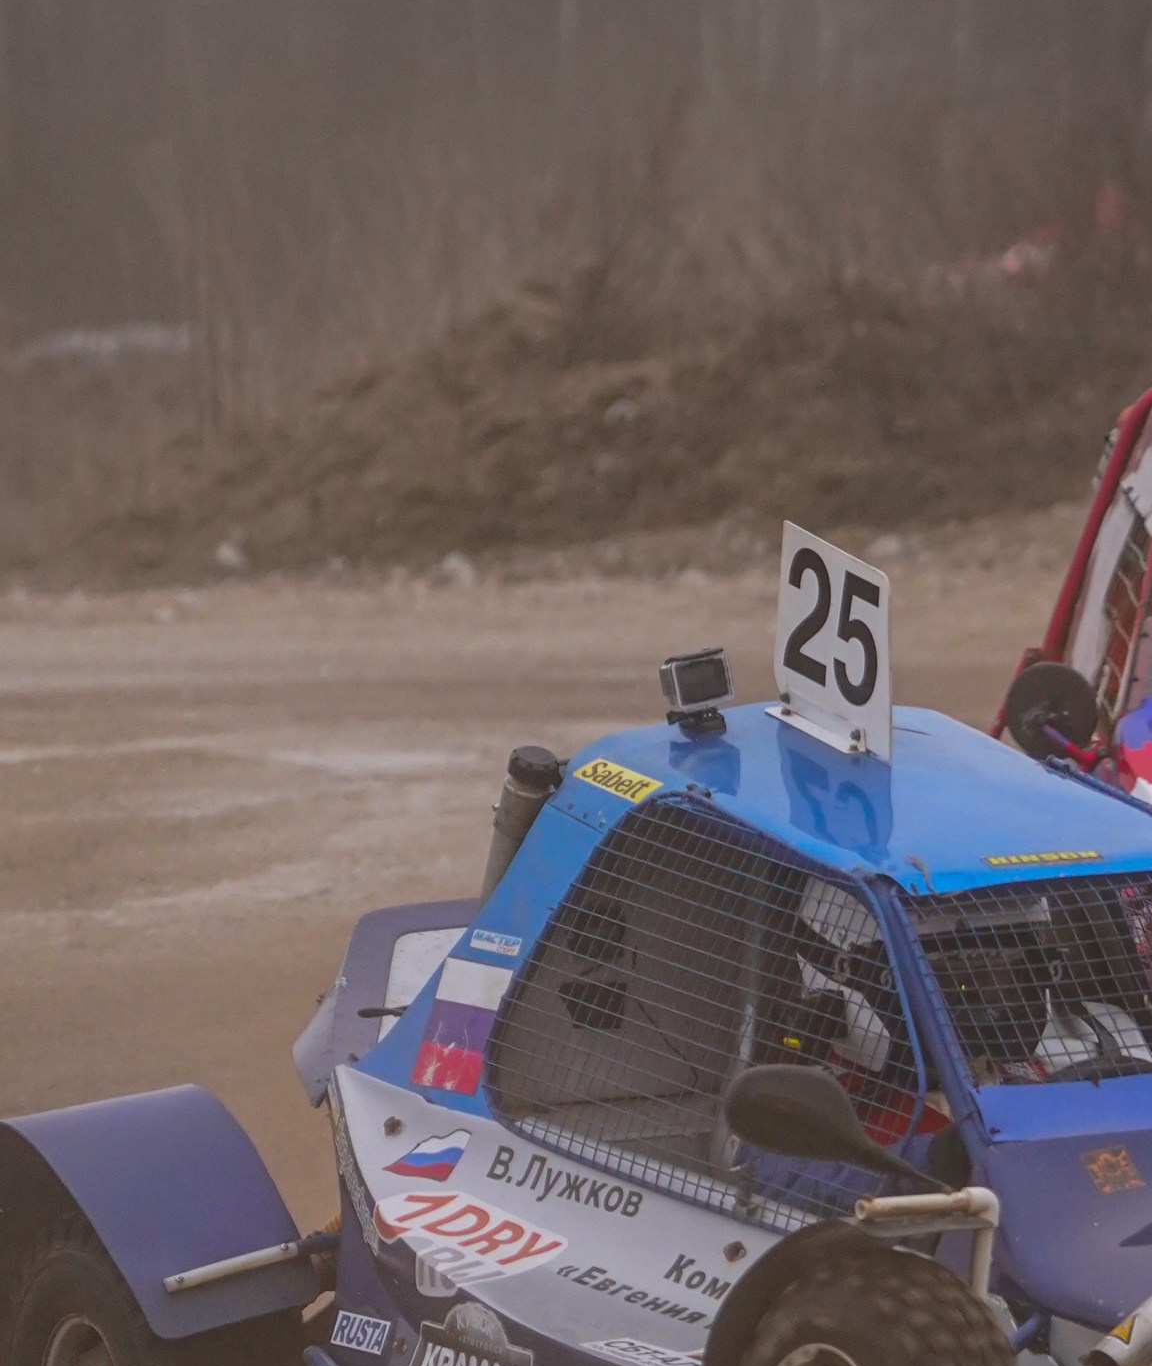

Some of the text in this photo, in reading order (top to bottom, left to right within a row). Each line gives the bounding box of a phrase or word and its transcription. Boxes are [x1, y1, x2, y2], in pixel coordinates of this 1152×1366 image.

[783, 547, 880, 707] 25
[580, 761, 653, 799] Sabelt
[485, 1145, 644, 1218] В.Лужков
[555, 1265, 708, 1325] «Евгения
[333, 1314, 387, 1352] RUSTA
